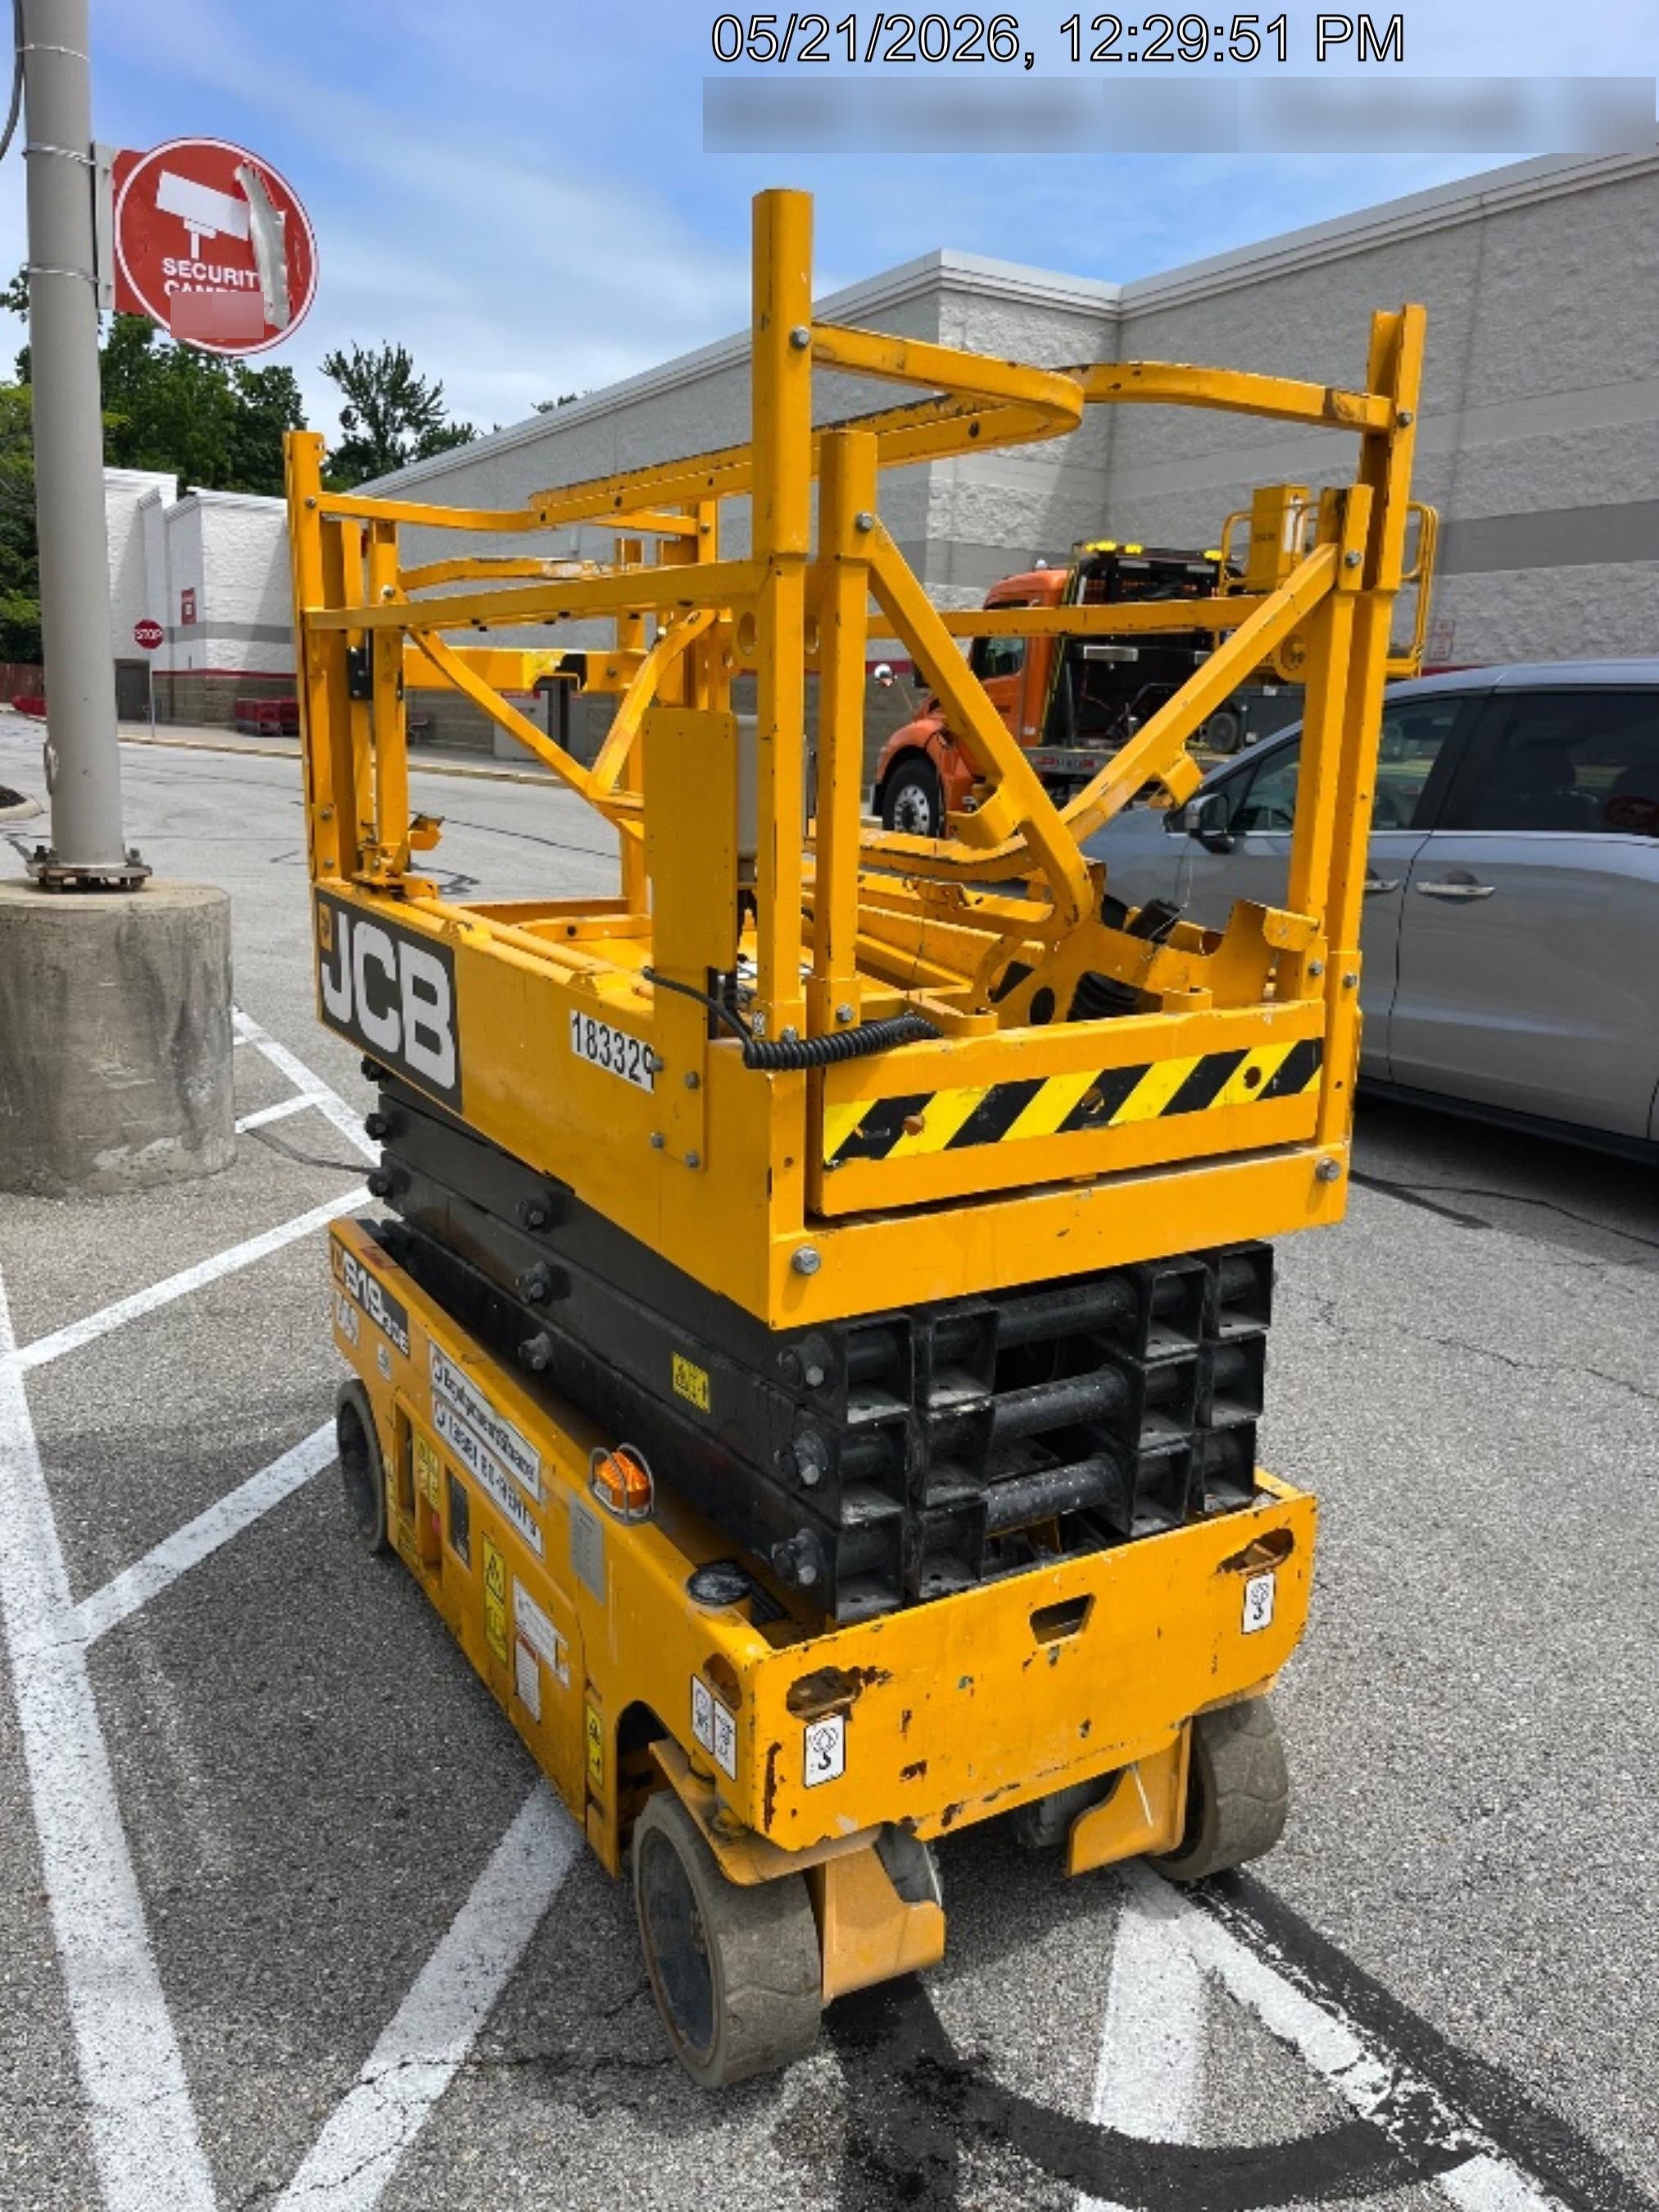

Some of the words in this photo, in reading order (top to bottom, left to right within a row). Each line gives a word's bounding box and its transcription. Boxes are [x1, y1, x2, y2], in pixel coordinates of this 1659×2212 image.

[161, 256, 259, 288] SECURIT
[134, 628, 163, 640] STOP
[320, 911, 456, 1090] JCB
[572, 1011, 655, 1090] 183329
